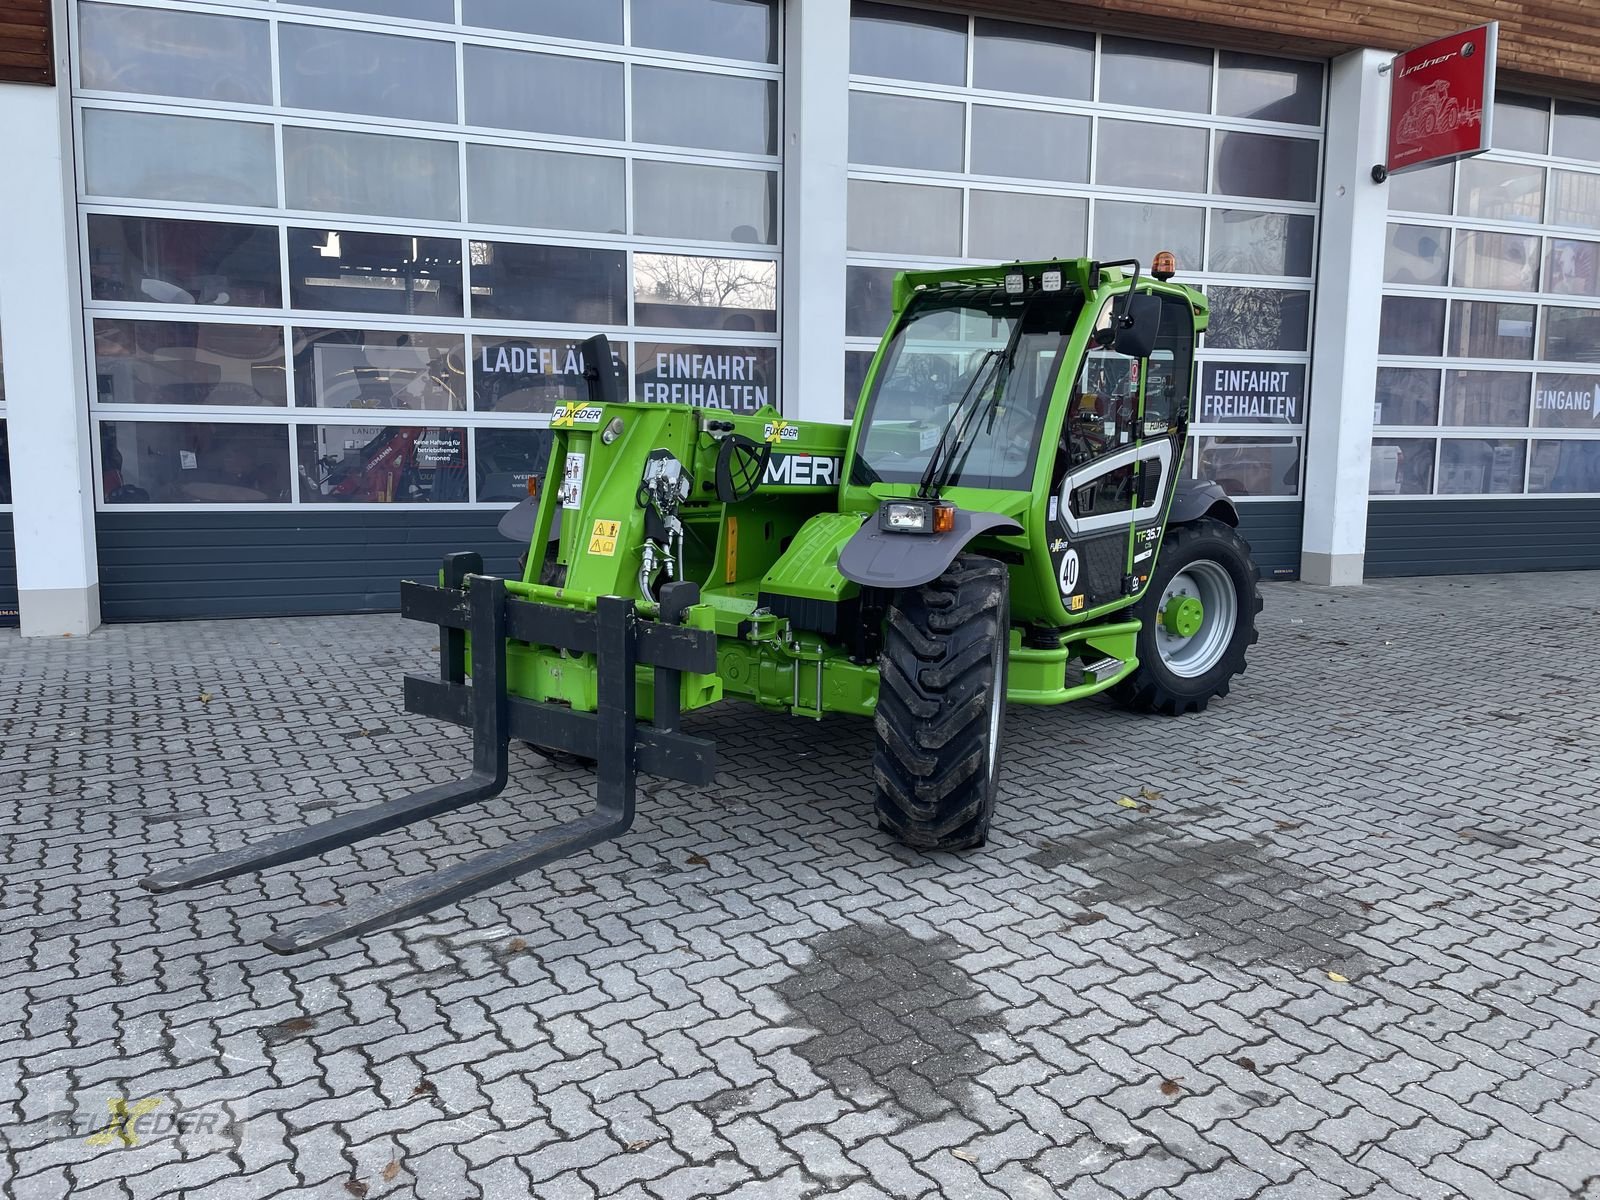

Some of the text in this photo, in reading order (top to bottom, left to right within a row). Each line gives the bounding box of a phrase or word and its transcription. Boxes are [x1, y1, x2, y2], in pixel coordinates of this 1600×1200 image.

[1399, 52, 1458, 78] Lindner
[481, 344, 619, 377] LADEFLÄE
[656, 352, 757, 381] EINFAHRT
[1215, 369, 1290, 393] EINFAHRT
[643, 382, 768, 410] FREIHALTEN
[1204, 394, 1296, 418] FREIHALTEN
[1536, 390, 1591, 410] EINGANG
[430, 439, 453, 447] Haftung
[1135, 526, 1162, 543] TF35.7
[1063, 558, 1076, 586] 40
